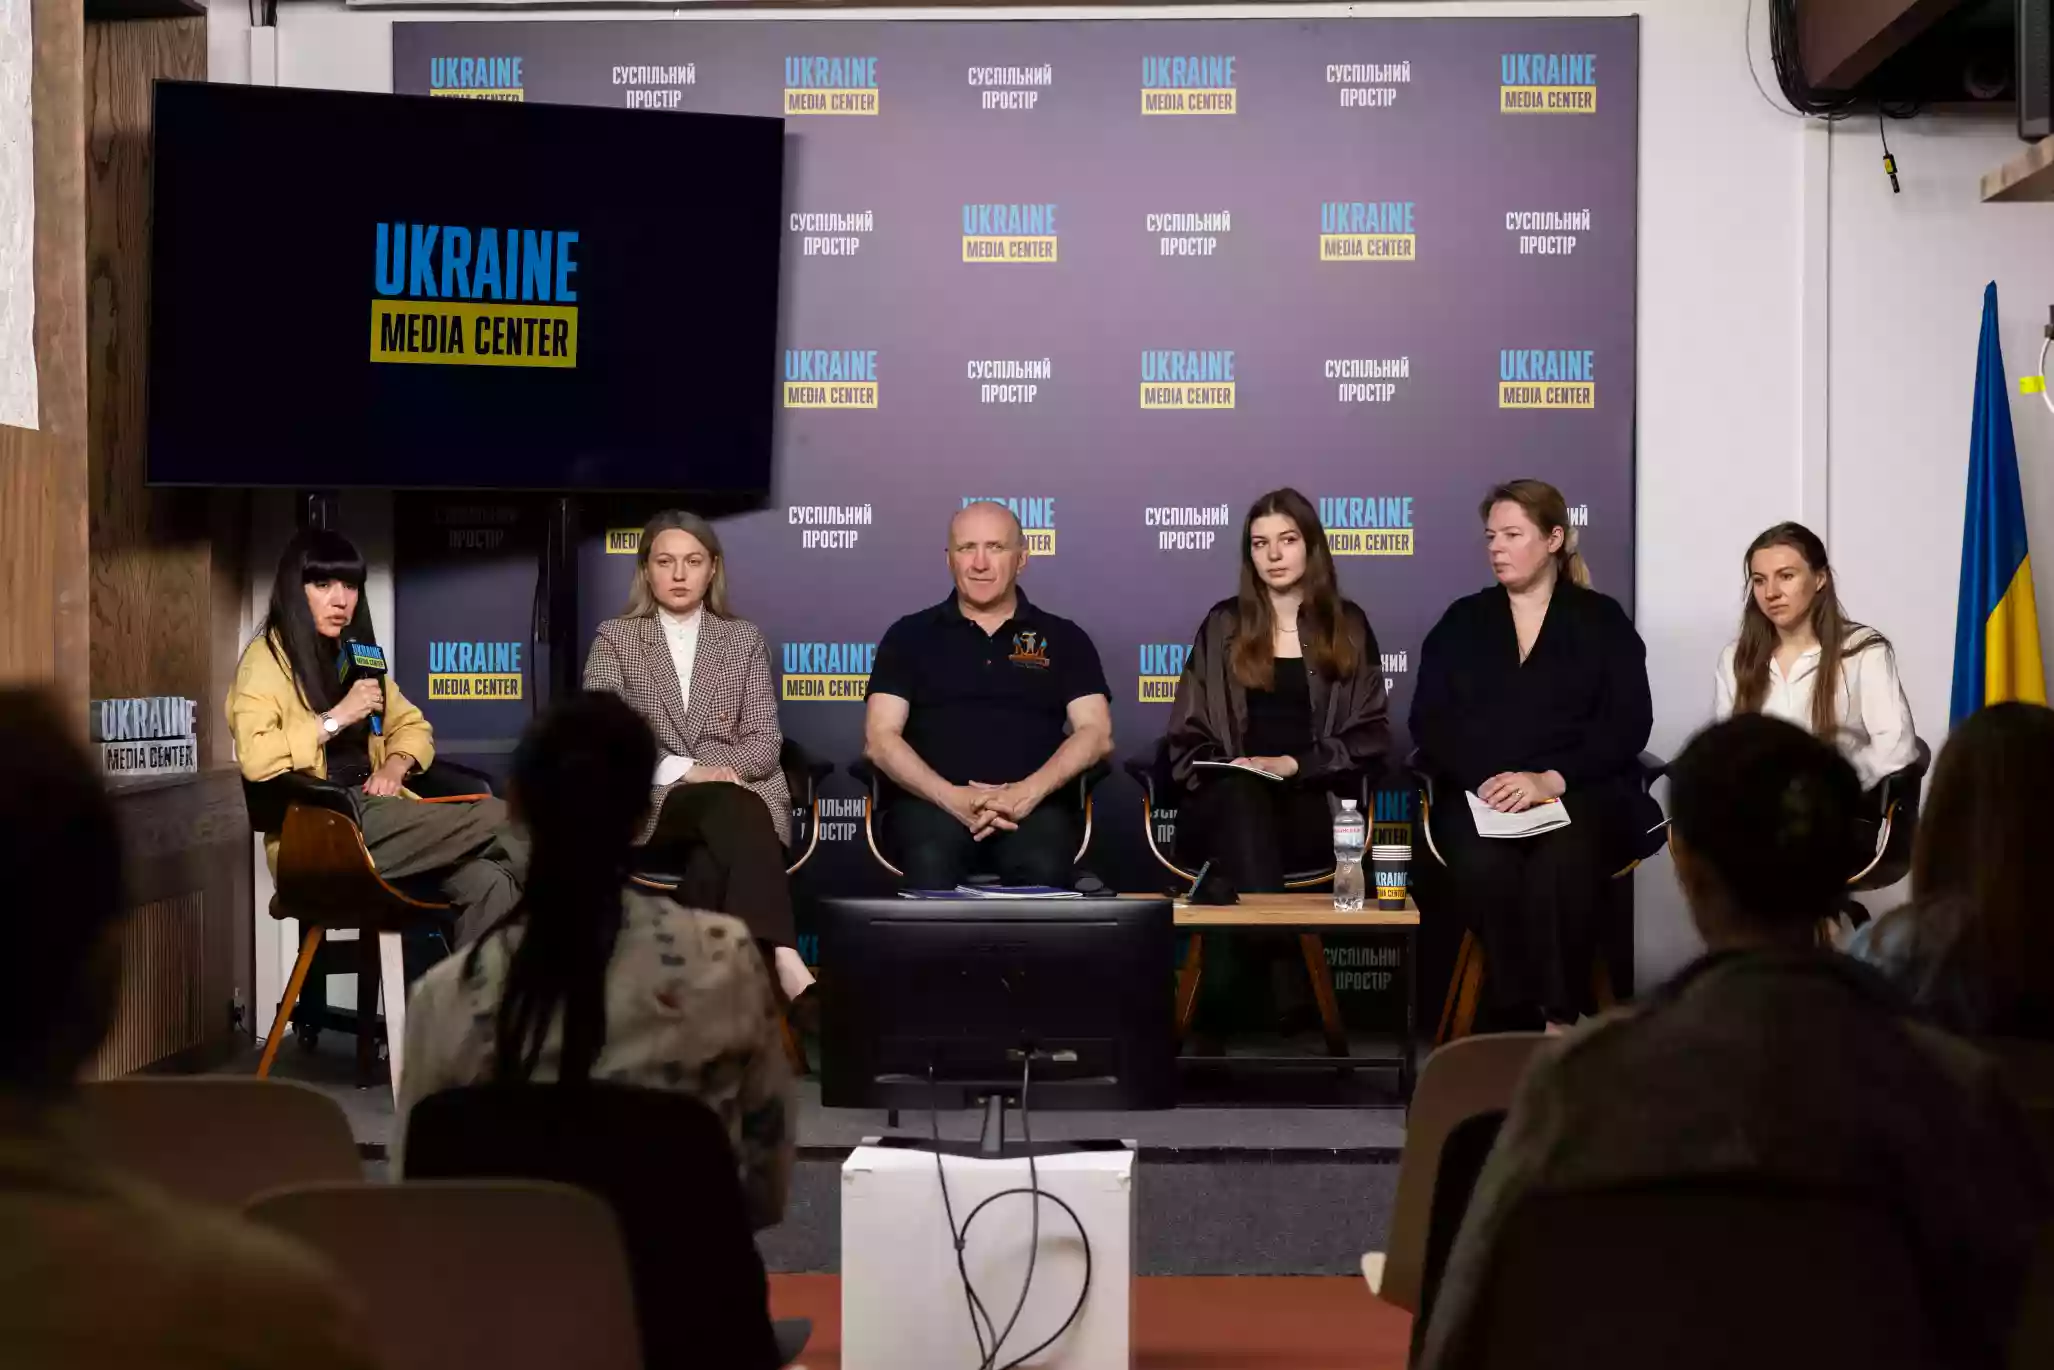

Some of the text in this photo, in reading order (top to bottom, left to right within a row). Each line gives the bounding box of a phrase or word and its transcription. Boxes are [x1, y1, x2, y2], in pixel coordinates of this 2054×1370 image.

[431, 57, 523, 88] UKRAINE
[612, 63, 696, 85] СУСПІЛЬНИЙ
[785, 56, 879, 88] UKRAINE
[968, 64, 1052, 86] СУСПІЛЬНИЙ
[1142, 56, 1236, 88] UKRAINE
[1326, 61, 1411, 83] СУСПІЛЬНИЙ
[1501, 53, 1597, 85] UKRAINE
[626, 90, 682, 108] ПРОСТІР
[788, 93, 875, 111] MEDIA CENTER
[982, 91, 1038, 109] ПРОСТІР
[1146, 93, 1232, 110] MEDIA CENTER
[1340, 88, 1397, 107] ПРОСТІР
[1505, 91, 1593, 108] MEDIA CENTER
[790, 210, 873, 232] СУСПІЛЬНИЙ
[963, 204, 1057, 235] UKRAINE
[1146, 211, 1231, 232] СУСПІЛЬНИЙ
[1321, 202, 1415, 233] UKRAINE
[1506, 209, 1590, 231] СУСПІЛЬНИЙ
[804, 237, 860, 255] ПРОСТІР
[967, 241, 1053, 258] MEDIA CENTER
[1160, 237, 1217, 256] ПРОСТІР
[1325, 239, 1411, 256] MEDIA CENTER
[1520, 236, 1577, 255] ПРОСТІР
[375, 222, 579, 302] UKRAINE
[380, 313, 569, 357] MEDIA CENTER
[785, 350, 878, 381] UKRAINE
[967, 357, 1051, 379] СУСПІЛЬНИЙ
[1141, 350, 1235, 381] UKRAINE
[1325, 356, 1409, 378] СУСПІЛЬНИЙ
[1500, 350, 1594, 380] UKRAINE
[788, 387, 874, 404] MEDIA CENTER
[981, 384, 1038, 403] ПРОСТІР
[1144, 388, 1231, 405] MEDIA CENTER
[1338, 384, 1396, 402] ПРОСТІР
[1504, 387, 1591, 404] MEDIA CENTER
[788, 504, 872, 525] СУСПІЛЬНИЙ
[1145, 504, 1229, 526] СУСПІЛЬНИЙ
[1320, 497, 1414, 527] UKRAINE
[610, 532, 641, 549] MEDI
[802, 530, 858, 548] ПРОСТІР
[1027, 534, 1052, 551] TER
[1159, 531, 1215, 550] ПРОСТІР
[1366, 534, 1410, 551] CENTER
[430, 642, 522, 672] UKRAINE
[783, 643, 876, 674] UKRAINE
[433, 679, 518, 696] MEDIA CENTER
[786, 680, 825, 697] MEDIA
[102, 696, 197, 741] UKRAINE
[107, 745, 194, 771] MEDIA CENTER
